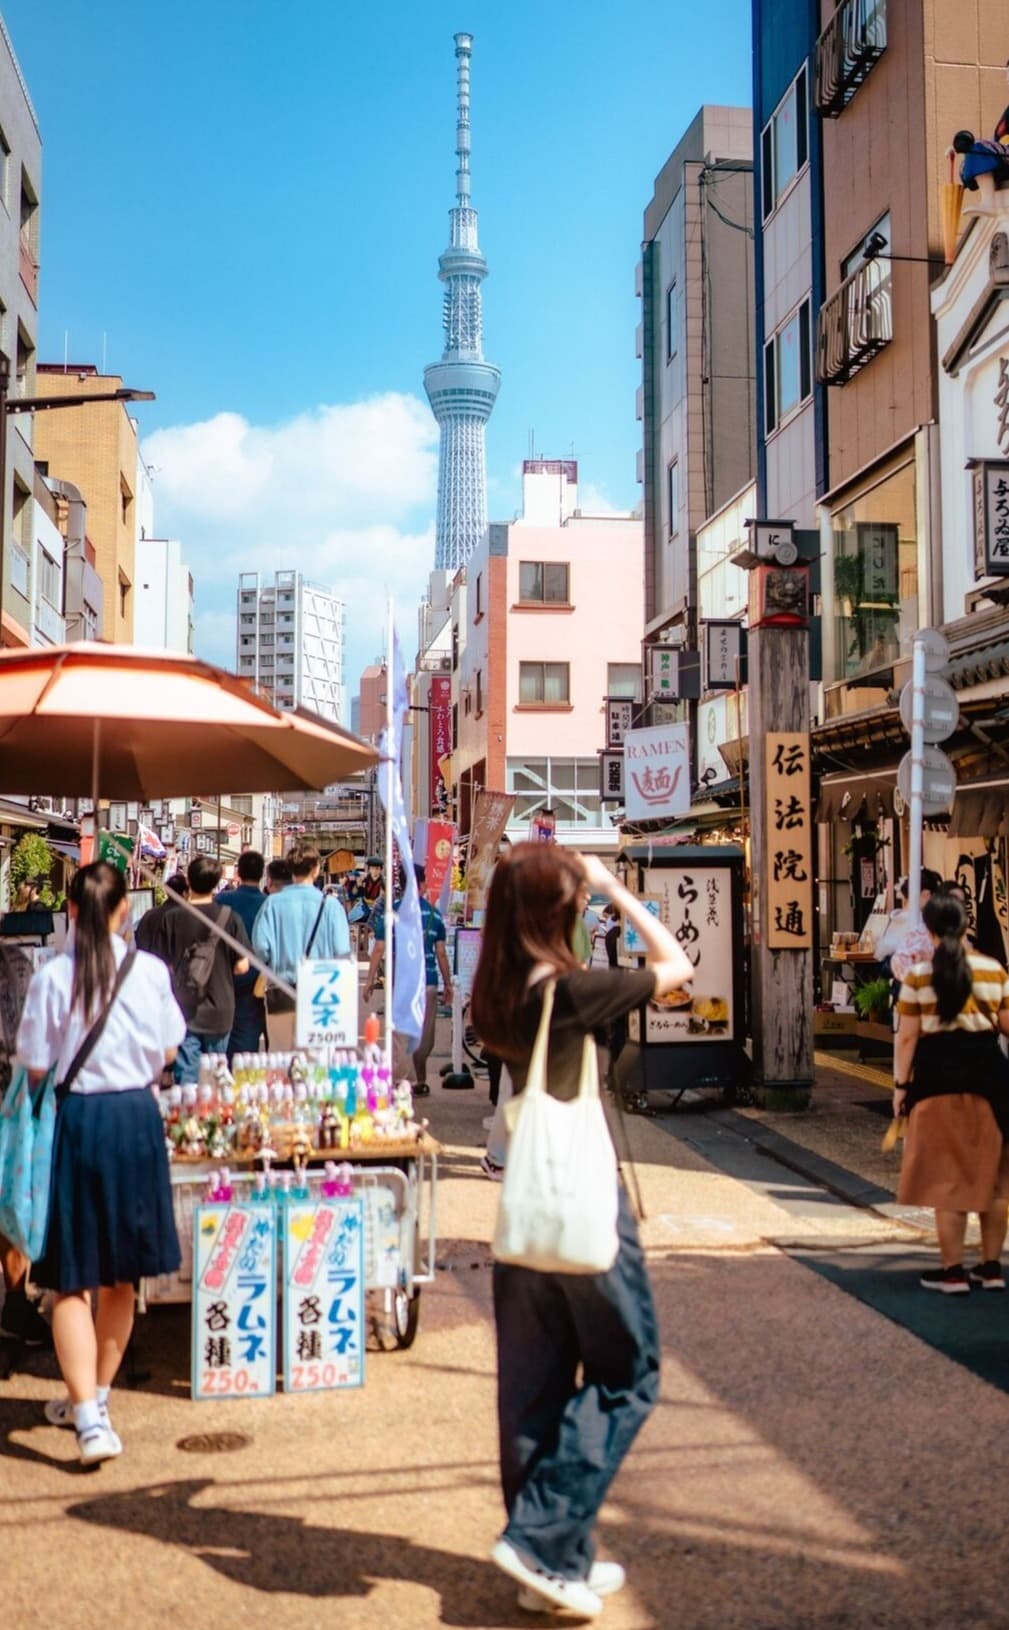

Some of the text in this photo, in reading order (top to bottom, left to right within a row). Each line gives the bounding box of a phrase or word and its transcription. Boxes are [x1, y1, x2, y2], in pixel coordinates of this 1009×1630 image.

[627, 738, 686, 759] RAMEN
[771, 744, 808, 938] 伝法院通
[312, 963, 340, 1027] ラムネ
[308, 1031, 345, 1044] 250円
[204, 1301, 231, 1369] 各種
[237, 1275, 267, 1363] ラムネ
[297, 1295, 322, 1361] 各種
[327, 1269, 357, 1355] ラムネ
